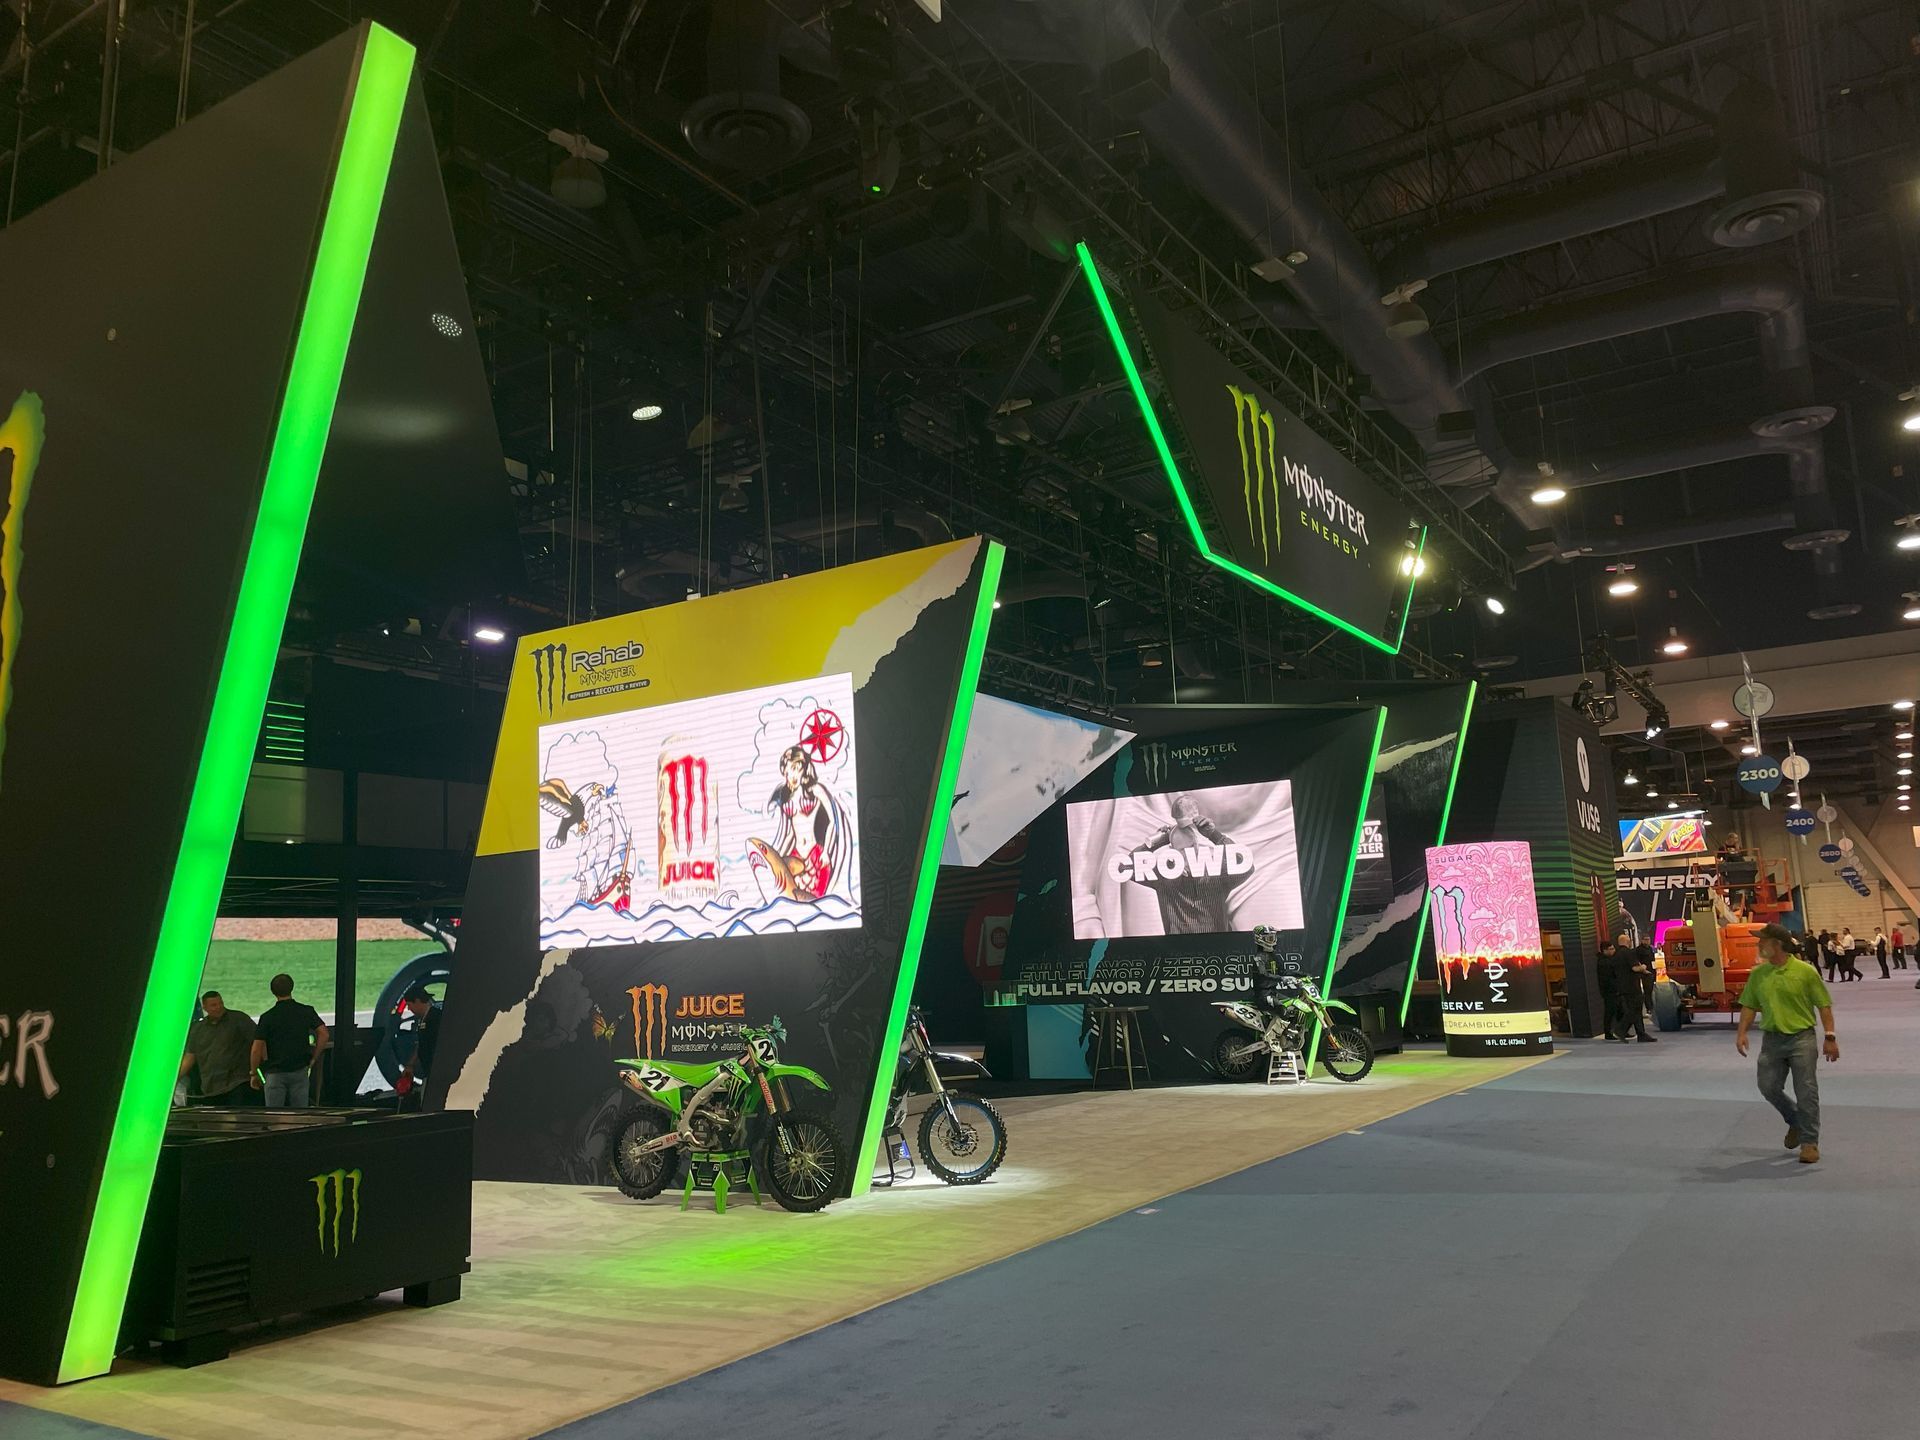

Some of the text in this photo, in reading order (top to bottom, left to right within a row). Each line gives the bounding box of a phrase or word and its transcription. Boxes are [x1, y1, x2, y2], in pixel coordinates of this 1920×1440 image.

[1283, 455, 1370, 546] MONSTER
[1300, 510, 1359, 560] ENERGY
[571, 641, 645, 673] Rehab
[579, 665, 636, 686] MONSTER
[595, 682, 625, 696] RECOVER
[1171, 742, 1238, 760] MONSTER
[1181, 755, 1228, 767] ENERGY
[1740, 767, 1780, 782] 2300
[1786, 817, 1815, 828] 2400
[1669, 820, 1697, 848] Cheetos
[1107, 843, 1255, 884] CROWD
[1434, 854, 1473, 864] SUGAR
[1616, 873, 1719, 891] ENERGY
[1017, 983, 1063, 997] FULL
[1065, 981, 1142, 995] FLAVOR
[1160, 978, 1218, 993] ZERO
[675, 992, 746, 1019] JUICE
[671, 1043, 710, 1053] ENERGY
[641, 1070, 671, 1092] 21
